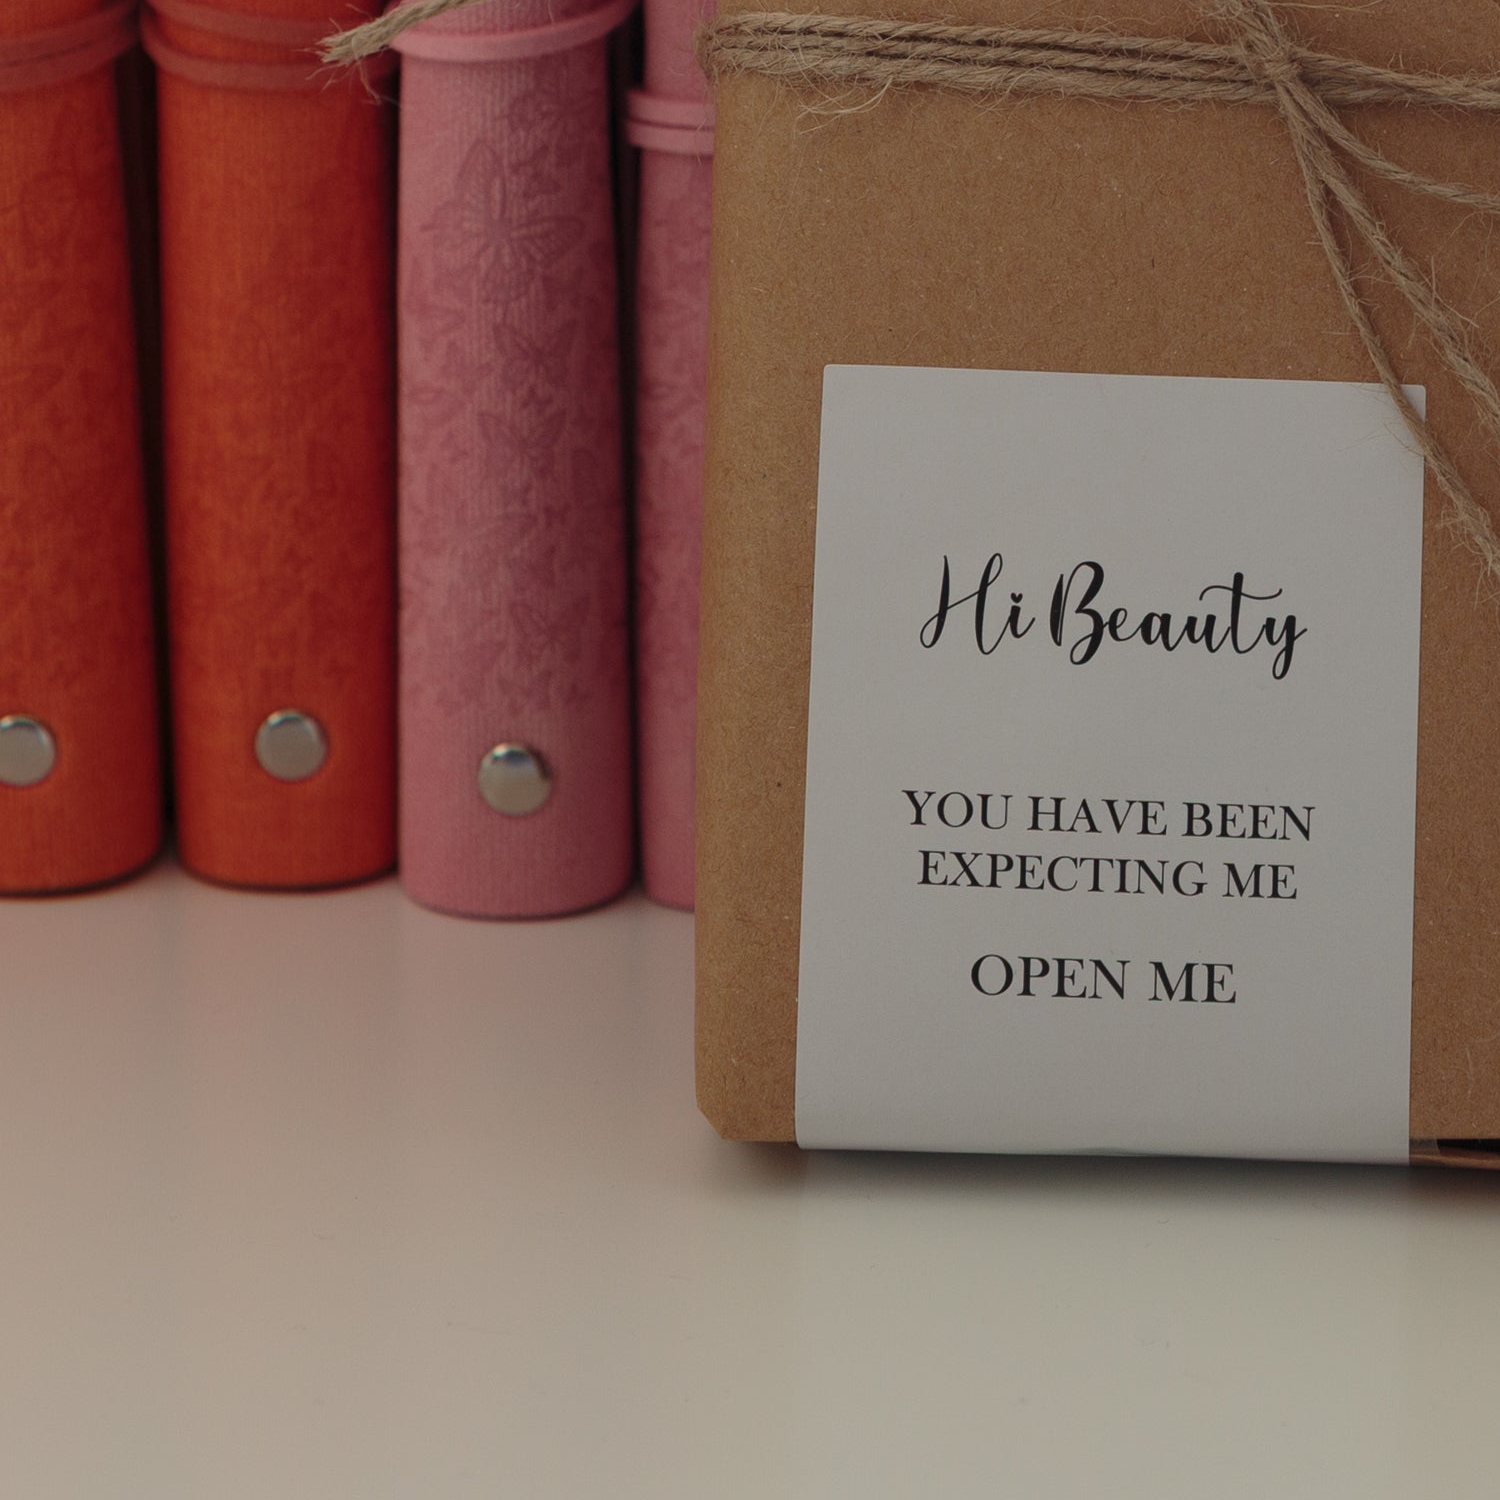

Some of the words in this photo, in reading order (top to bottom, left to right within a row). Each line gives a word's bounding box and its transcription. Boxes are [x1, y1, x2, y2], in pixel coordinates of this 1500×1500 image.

[919, 552, 1036, 656] Hi
[1049, 560, 1308, 681] Beauty
[901, 789, 1014, 831] YOU
[1027, 795, 1168, 837] HAVE
[1181, 801, 1316, 843] BEEN
[917, 850, 1208, 898] EXPECTING
[1222, 862, 1298, 901] ME
[970, 954, 1131, 1001] OPEN
[1148, 961, 1237, 1005] ME
